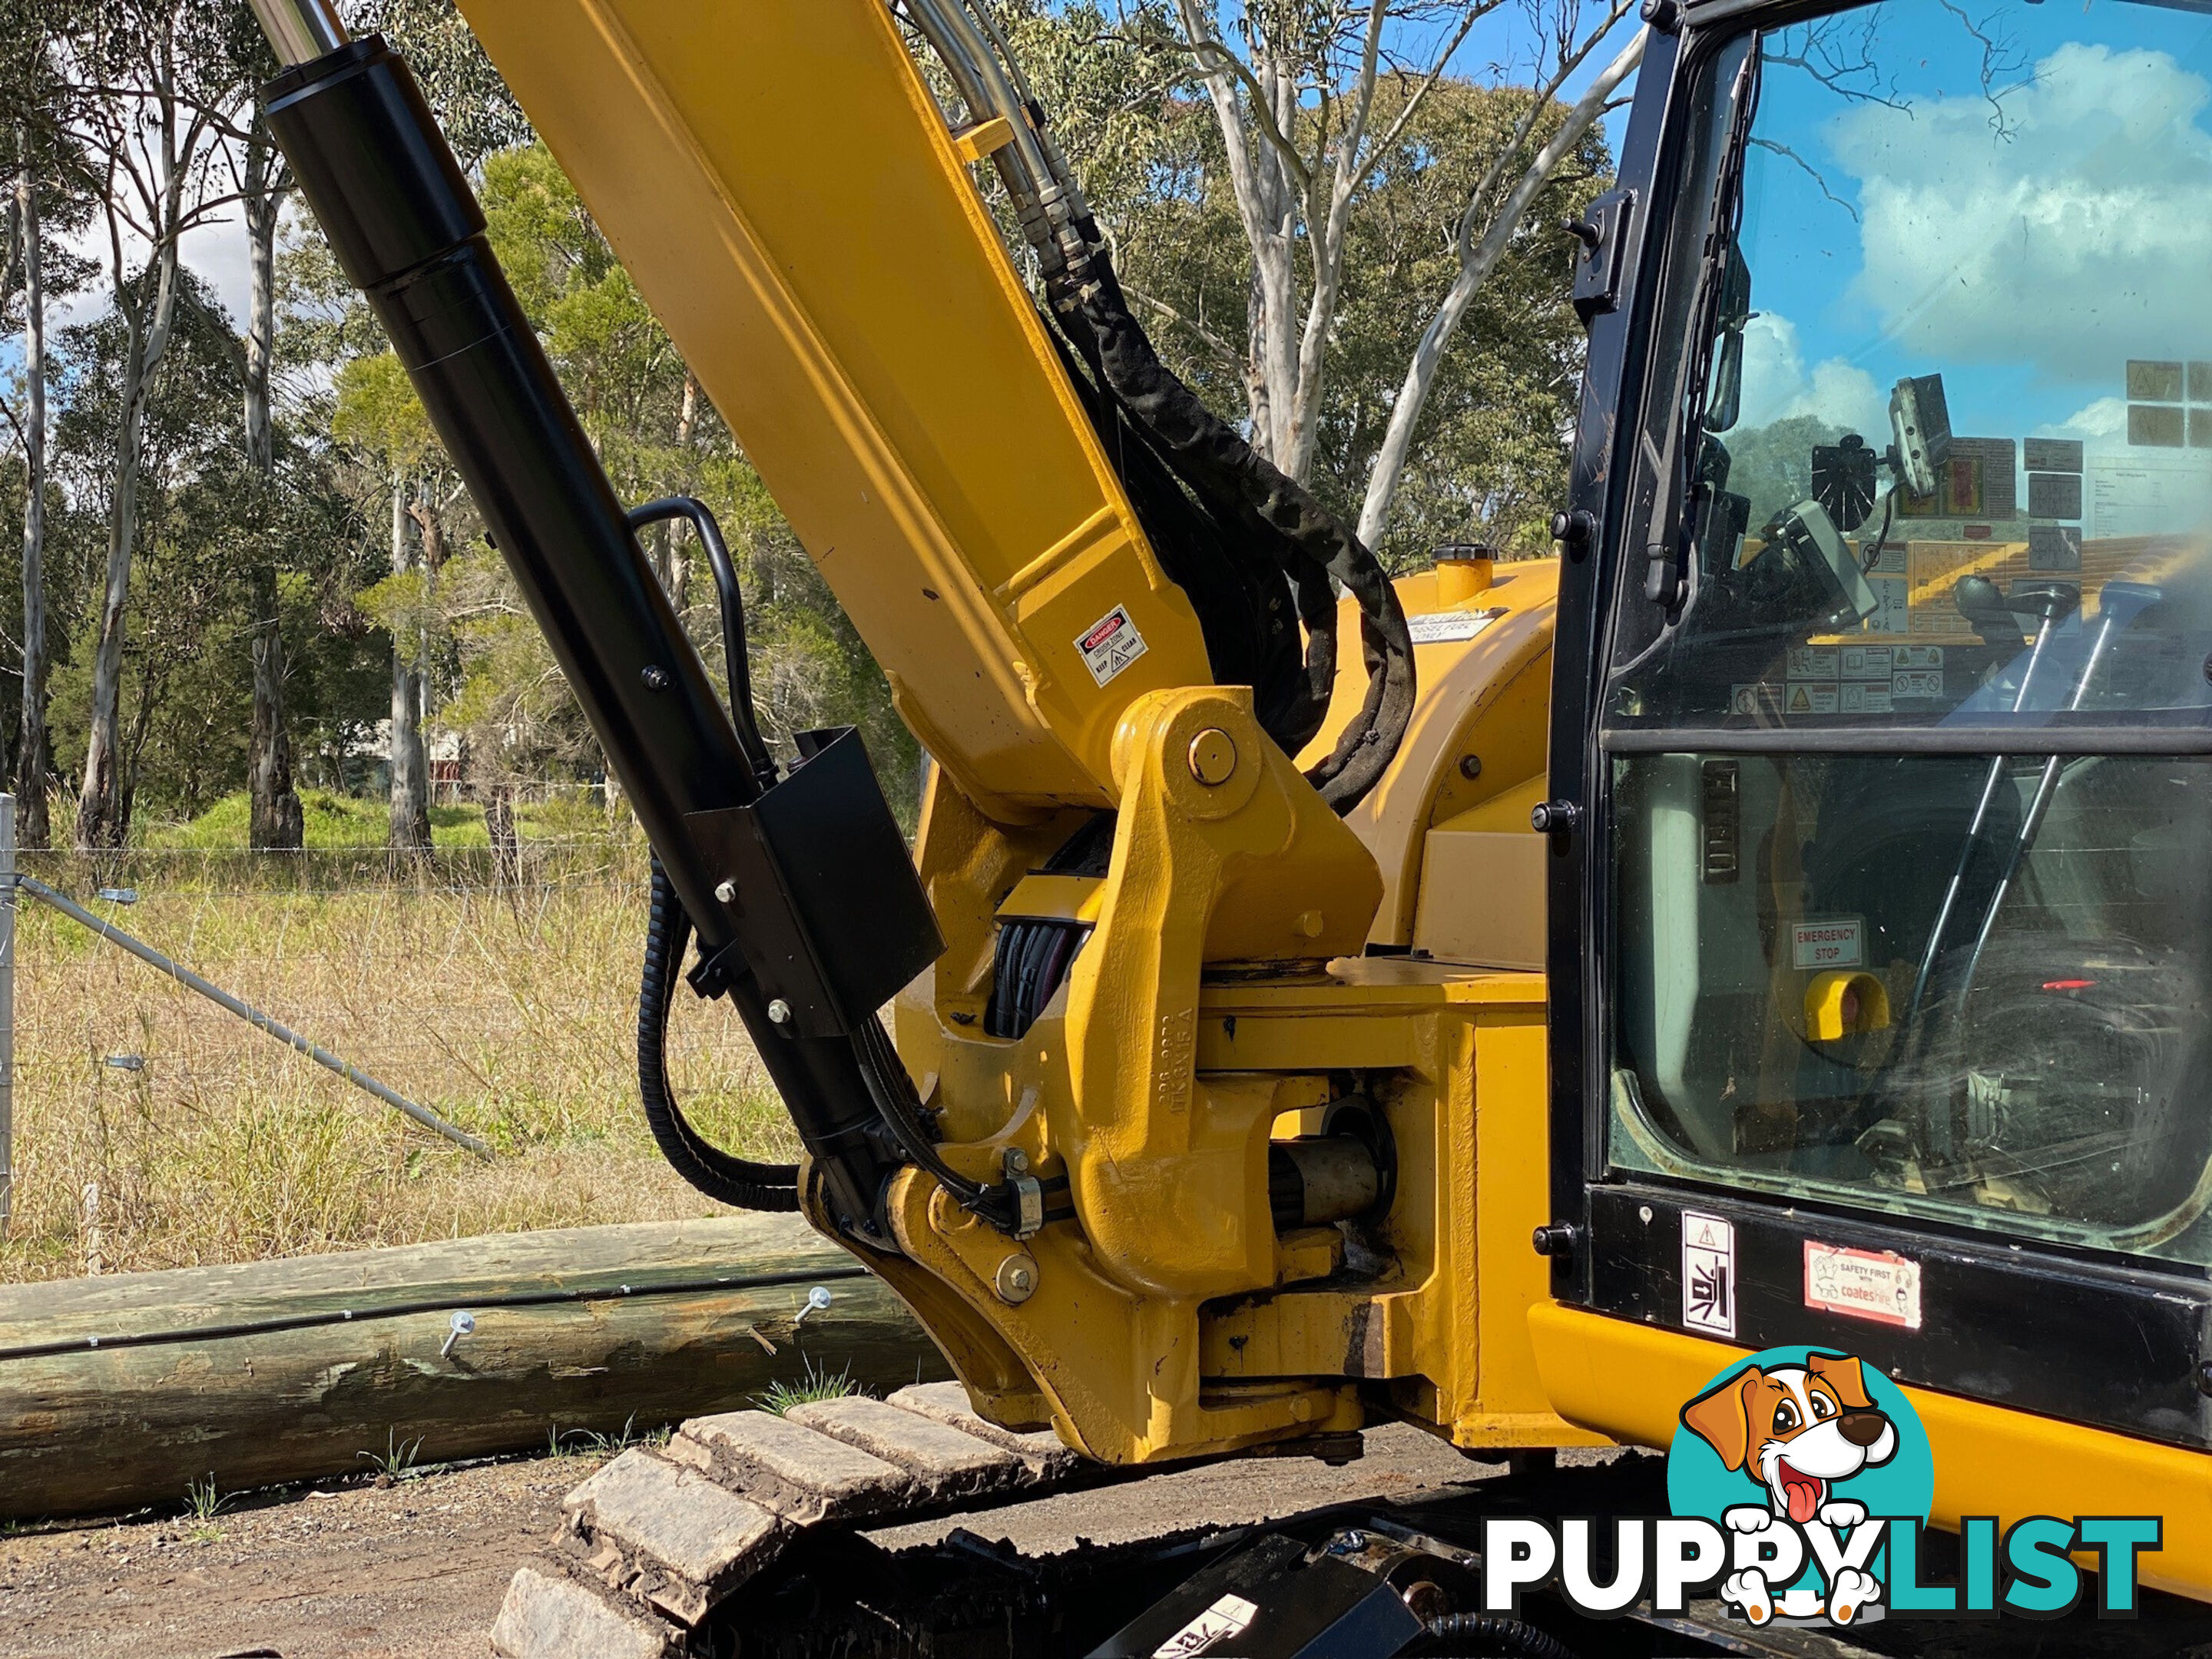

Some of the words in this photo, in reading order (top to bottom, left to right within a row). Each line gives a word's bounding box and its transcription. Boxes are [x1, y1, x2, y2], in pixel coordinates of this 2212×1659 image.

[1090, 621, 1117, 645] DANGER
[1094, 641, 1111, 657] CRUSH
[1110, 631, 1124, 644] ZONE
[1096, 660, 1108, 674] KEEP
[1121, 637, 1137, 652] CLEAR
[1797, 928, 1856, 943] EMERGENCY
[1815, 947, 1839, 960] STOP
[1840, 1263, 1868, 1275] SAFETY
[1869, 1268, 1891, 1280] FIRST
